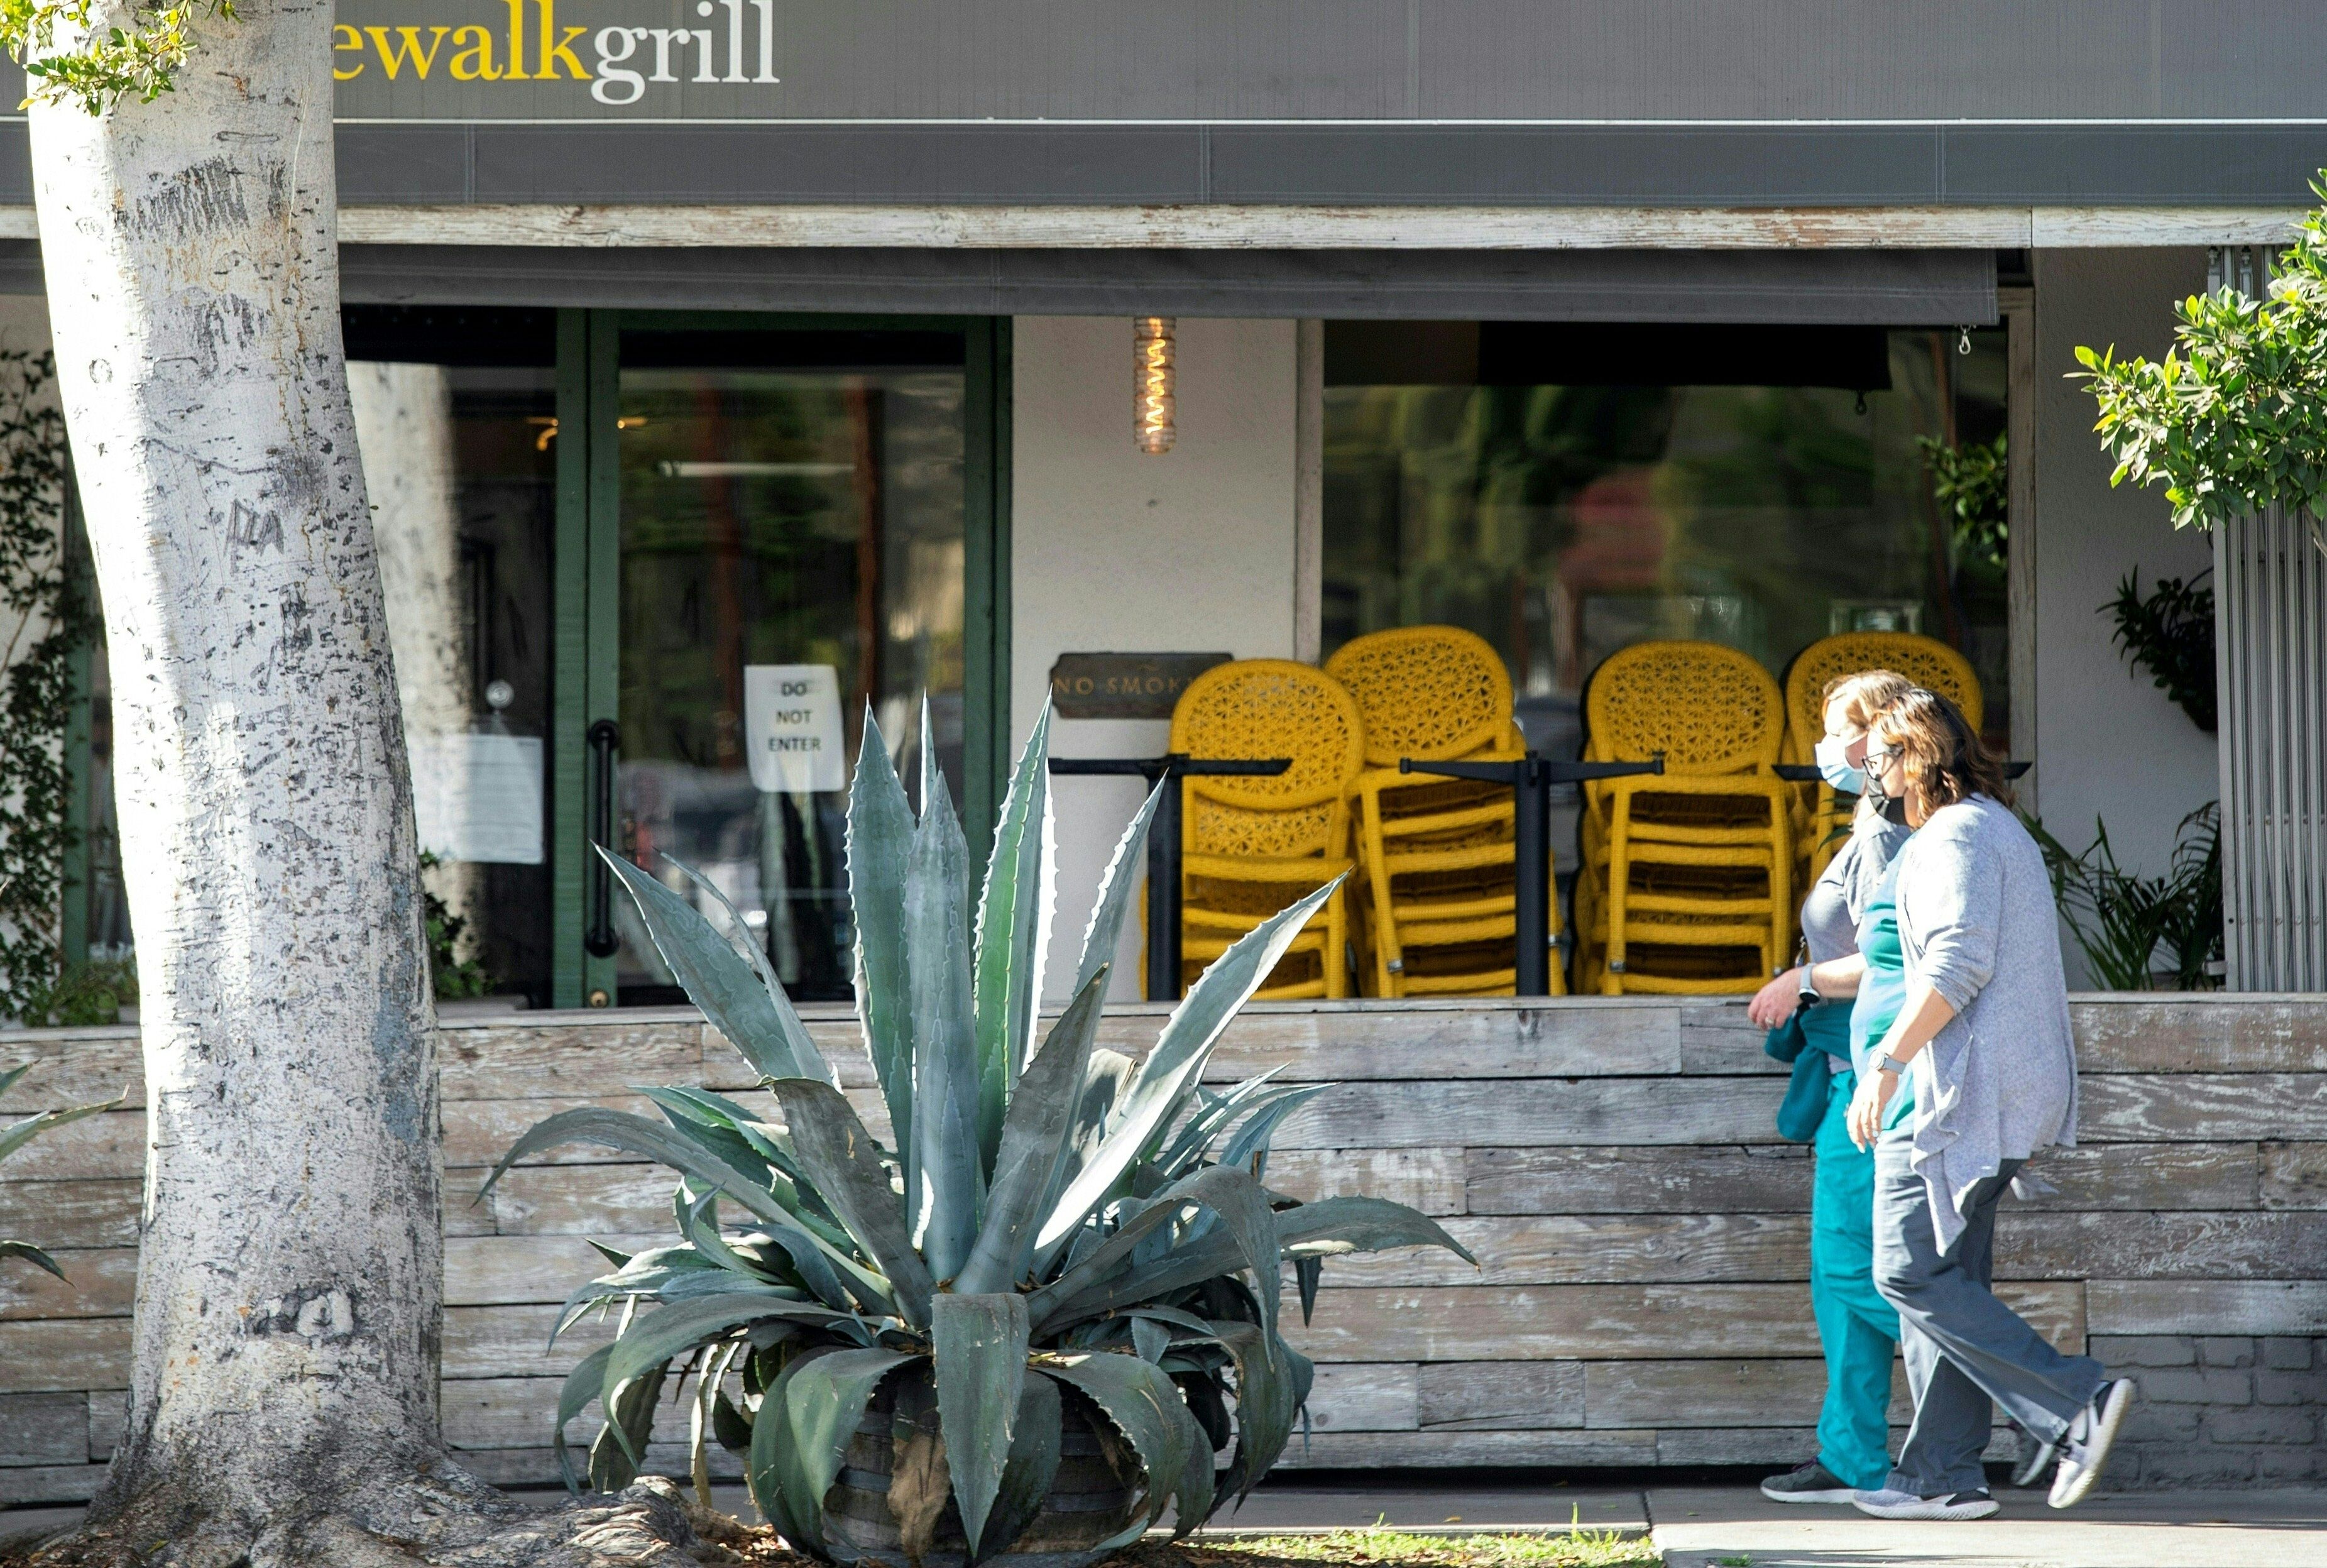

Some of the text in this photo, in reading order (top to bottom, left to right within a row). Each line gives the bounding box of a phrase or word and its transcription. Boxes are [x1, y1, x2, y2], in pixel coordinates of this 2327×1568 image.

[781, 681, 808, 696] DO
[1053, 676, 1193, 695] NO SMOK
[775, 709, 812, 724] NOT
[769, 737, 821, 752] ENTER
